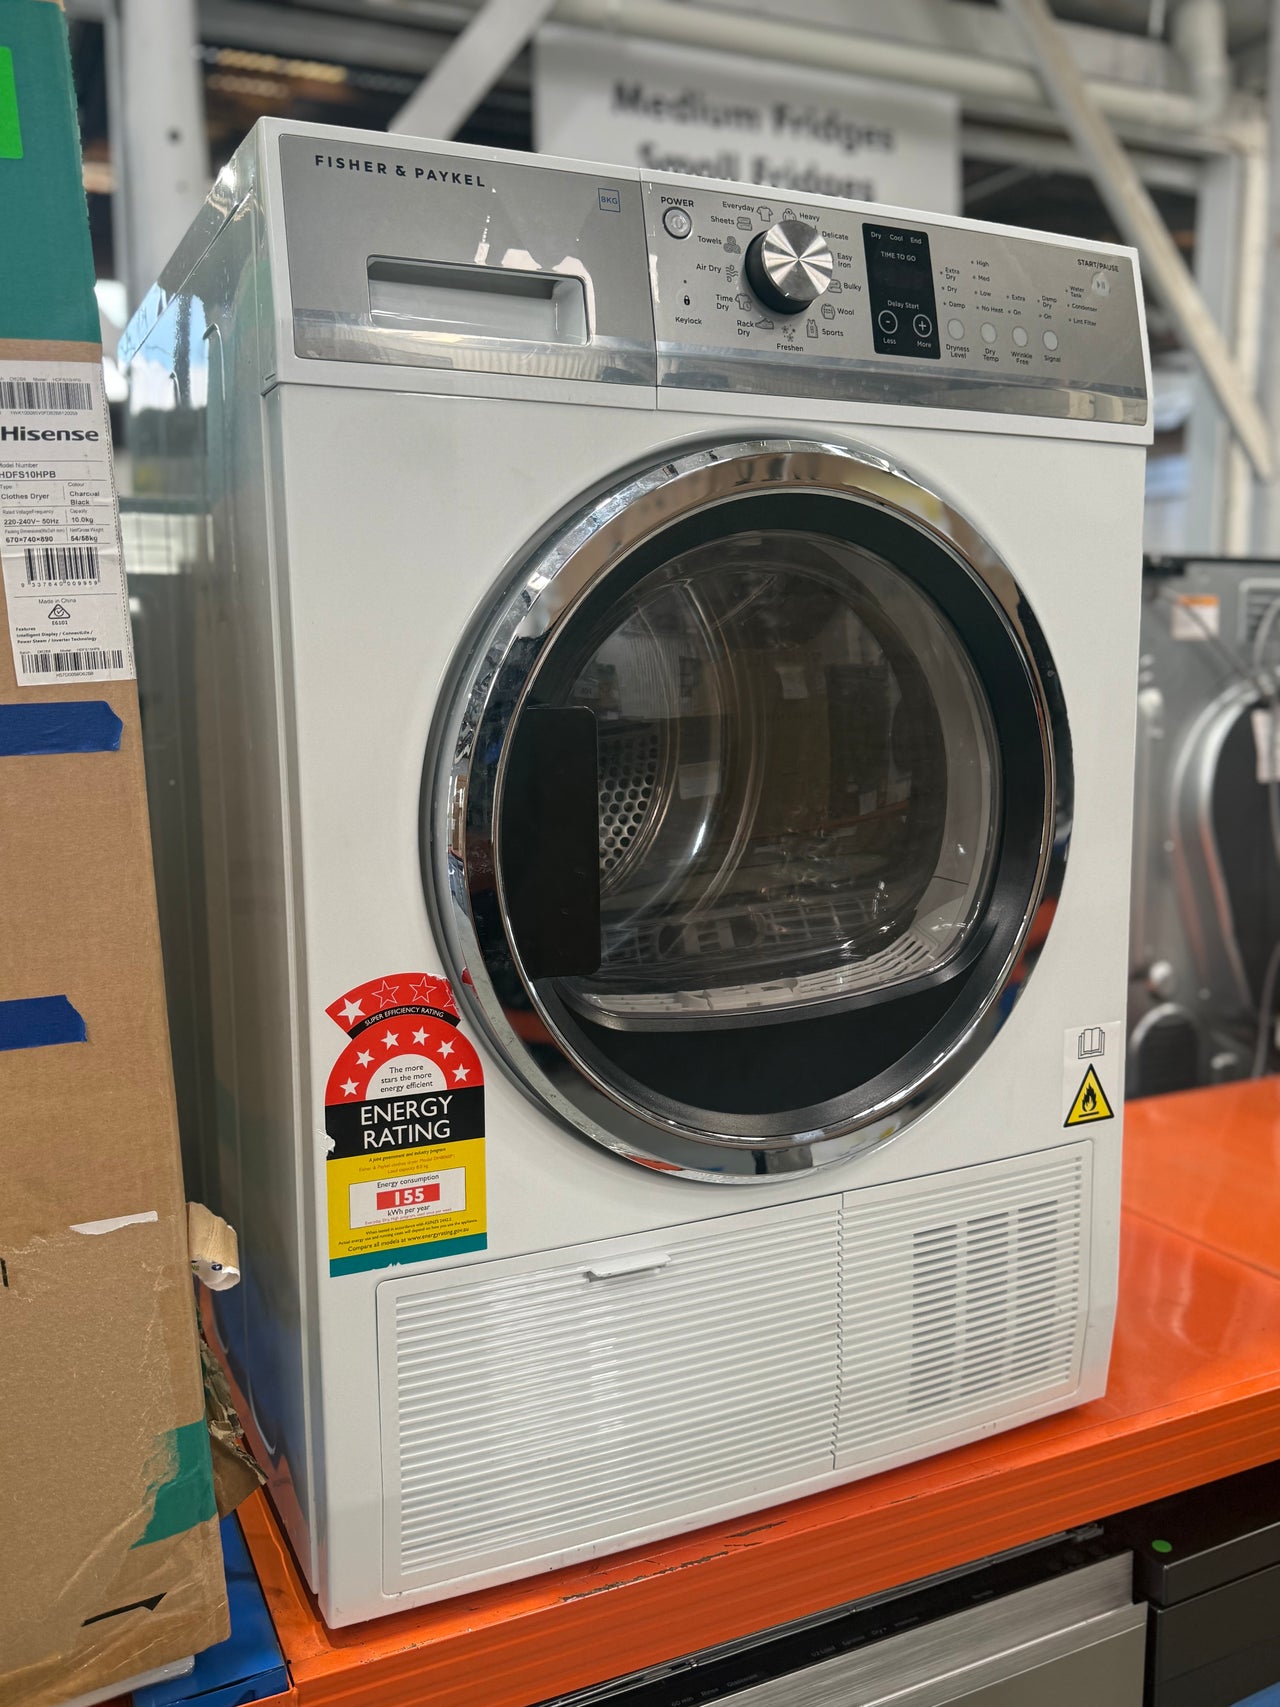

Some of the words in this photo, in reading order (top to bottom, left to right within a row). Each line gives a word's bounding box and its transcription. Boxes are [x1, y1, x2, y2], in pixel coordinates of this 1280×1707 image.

[612, 81, 761, 129] Medium
[773, 103, 896, 152] Fridges
[640, 140, 741, 180] Small
[315, 155, 387, 175] FISHER
[395, 164, 407, 177] &
[415, 167, 486, 187] PAYKEL
[601, 195, 618, 205] 8KG
[661, 197, 694, 208] POWER
[723, 201, 754, 212] Everyday
[711, 216, 734, 225] Sheets
[800, 212, 820, 222] Heavy
[822, 231, 848, 240] Delicate
[871, 231, 881, 239] Dry
[889, 234, 903, 242] Cool
[698, 236, 722, 245] Towels
[837, 253, 852, 262] Easy
[881, 251, 895, 259] TIME
[977, 260, 989, 268] High
[1077, 259, 1119, 272] START/PAUSE
[708, 265, 721, 273] Dry
[945, 267, 960, 275] Extra
[844, 283, 861, 292] Bulky
[947, 285, 957, 293] Dry
[717, 303, 729, 311] Dry
[888, 300, 904, 309] Delay
[949, 301, 965, 309] Damp
[837, 308, 854, 316] Wool
[675, 316, 702, 326] Keylock
[737, 320, 754, 328] Rack
[738, 329, 750, 337] Dry
[822, 328, 843, 337] Sports
[777, 343, 804, 352] Freshen
[917, 340, 931, 348] More
[946, 344, 970, 352] Dryness
[983, 354, 999, 362] Temp
[1043, 355, 1061, 363] Signal
[1, 426, 99, 441] Hisense
[365, 1014, 384, 1026] SUPER
[384, 1007, 420, 1017] EFFICIENCY
[421, 1008, 444, 1018] RATING
[389, 1066, 403, 1074] The
[381, 1076, 398, 1084] stars
[400, 1074, 412, 1083] the
[380, 1085, 404, 1093] energy
[406, 1081, 433, 1090] efficient
[361, 1095, 453, 1126] ENERGY
[364, 1120, 450, 1149] RATING
[400, 1174, 439, 1185] consumption
[394, 1188, 424, 1205] 155
[388, 1208, 403, 1217] kWh
[405, 1206, 415, 1216] per
[417, 1204, 430, 1213] year
[348, 1243, 372, 1252] Compare
[381, 1238, 400, 1246] models
[407, 1227, 469, 1243] www.energyrating.gov.au
